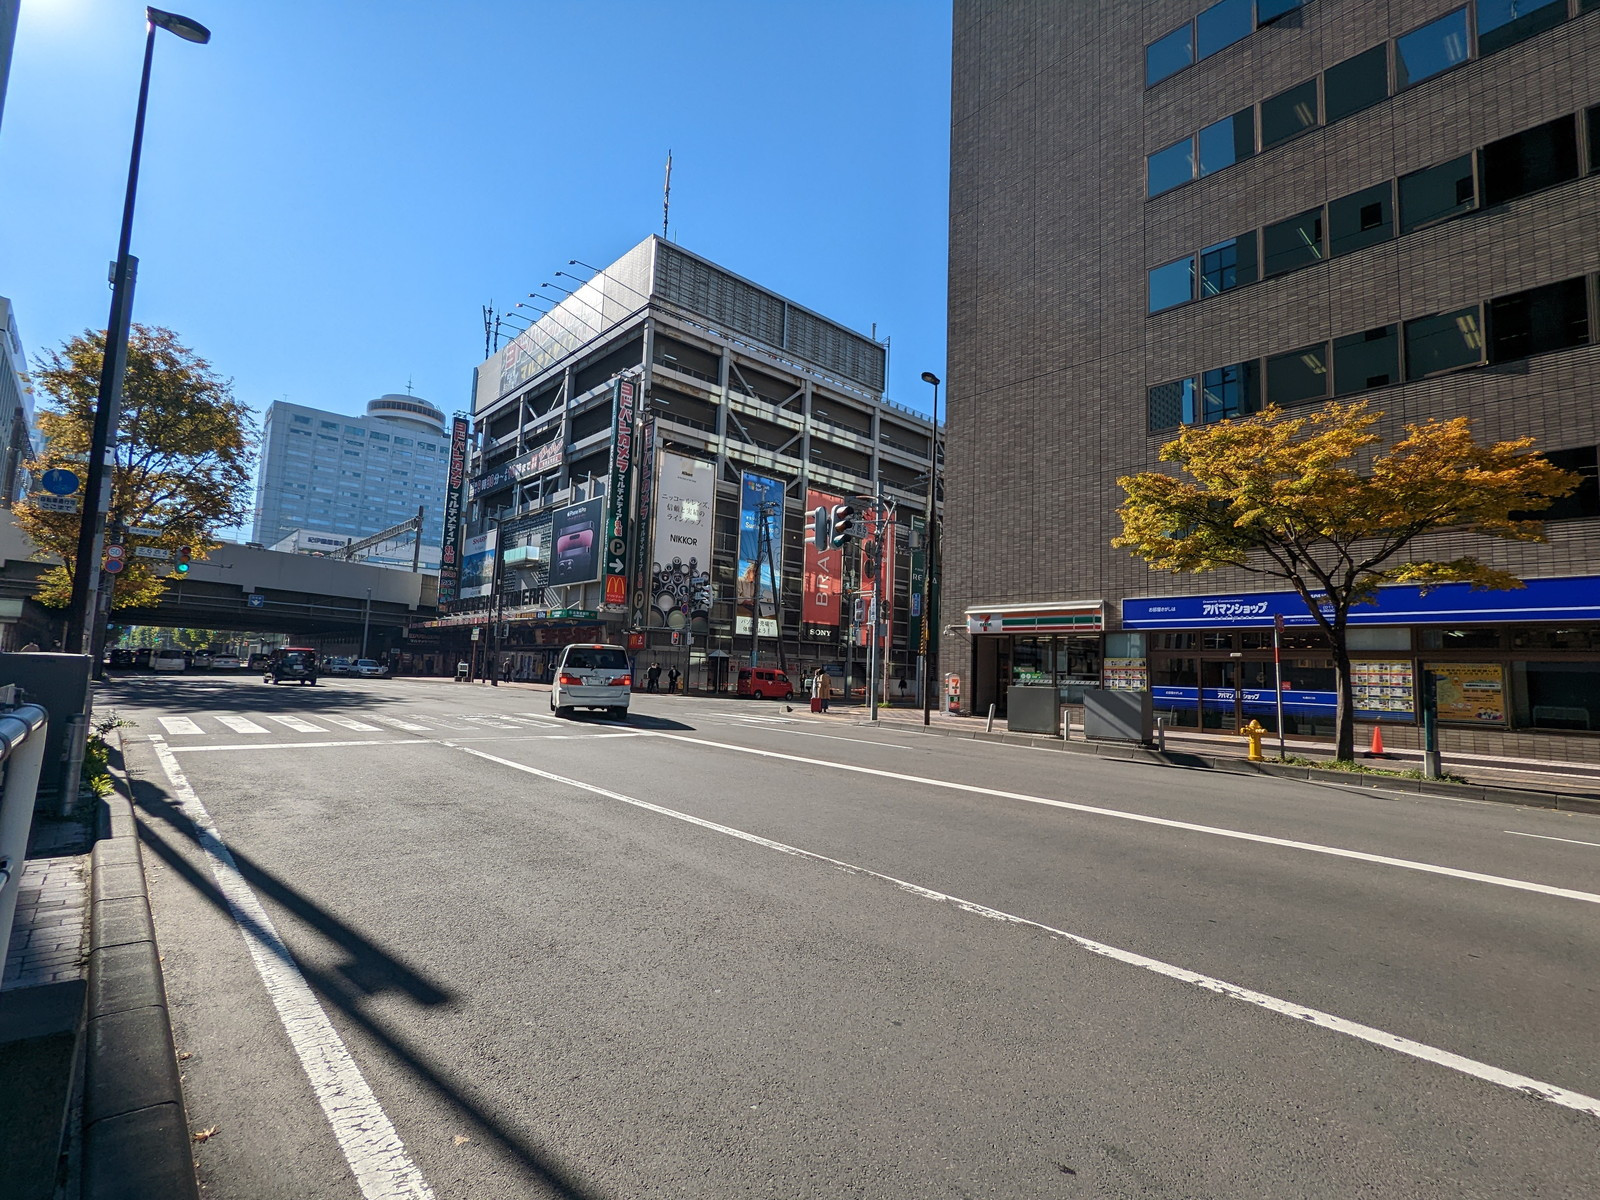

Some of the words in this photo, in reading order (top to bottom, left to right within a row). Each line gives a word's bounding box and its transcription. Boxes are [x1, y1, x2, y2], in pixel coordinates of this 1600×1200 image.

[616, 382, 633, 473] ヨドバシカメラ
[451, 422, 466, 489] ヨドバシカメラ
[42, 503, 72, 511] ここまで
[473, 535, 488, 545] SHARP
[670, 534, 698, 546] NIKKOR
[816, 546, 830, 606] BRA
[1203, 601, 1268, 615] アパマンショップ
[809, 629, 832, 637] SONY
